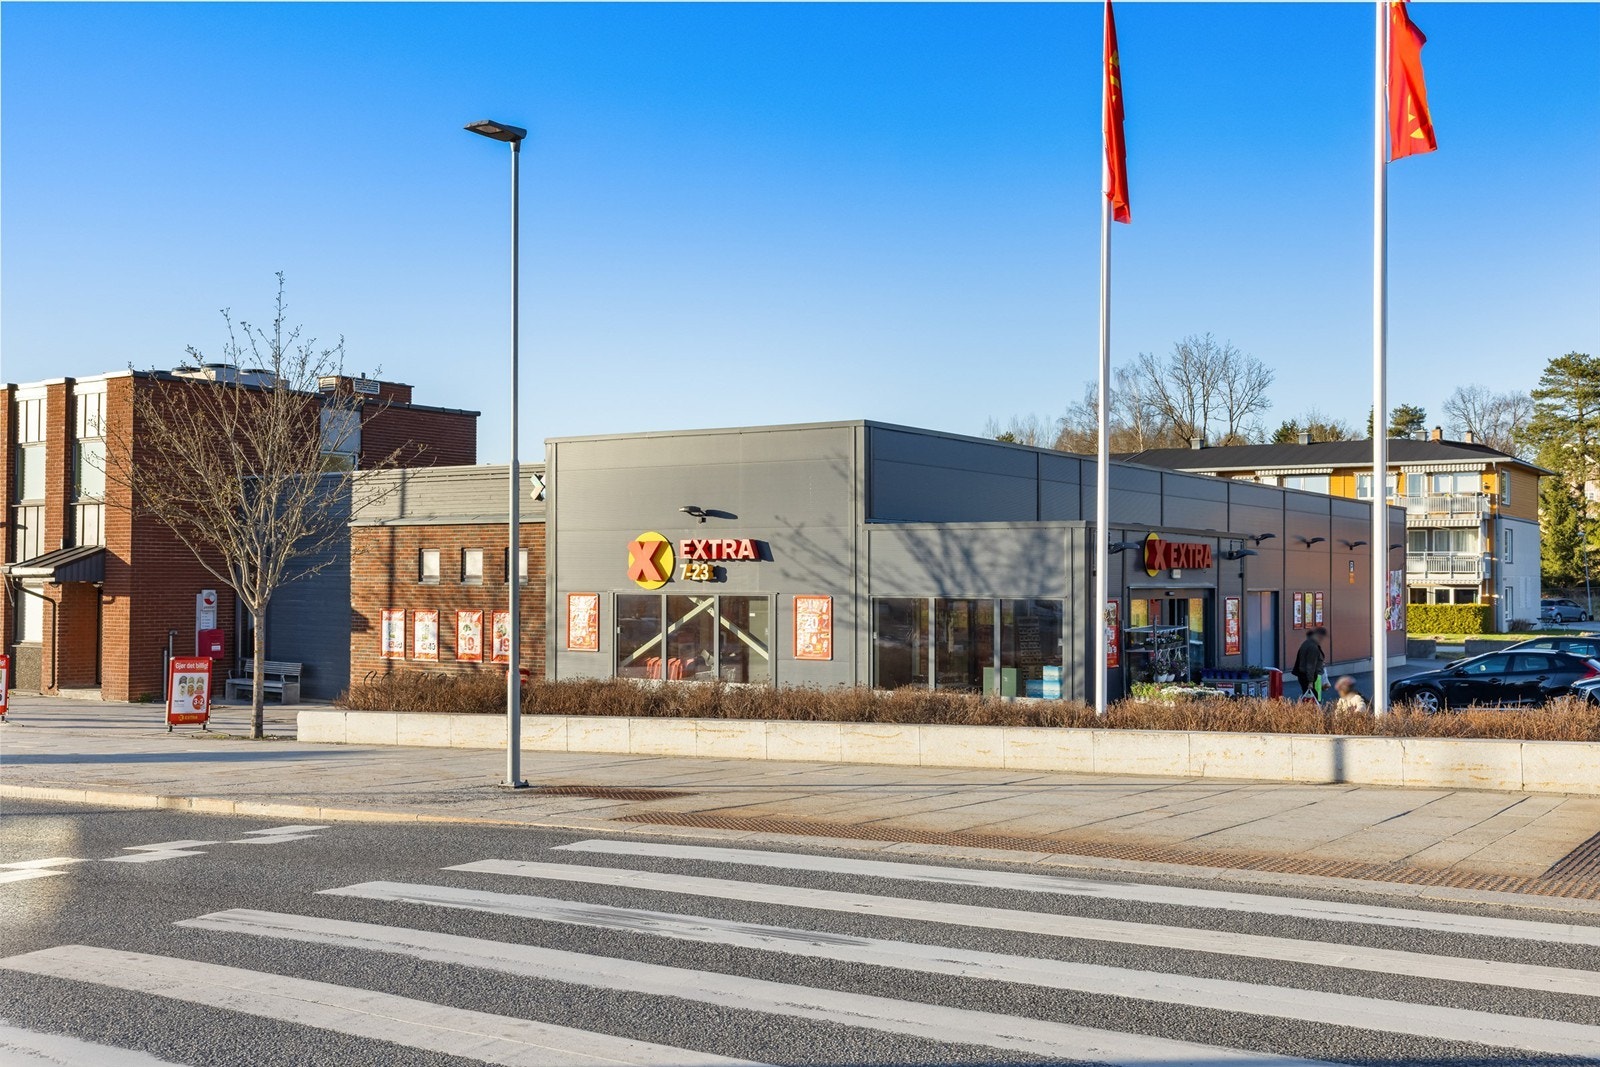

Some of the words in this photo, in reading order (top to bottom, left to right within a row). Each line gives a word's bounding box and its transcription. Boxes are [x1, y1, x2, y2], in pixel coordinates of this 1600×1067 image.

[680, 539, 757, 561] EXTRA
[1170, 543, 1212, 568] EXTRA
[680, 563, 710, 581] 7-23
[175, 662, 186, 670] Gjør
